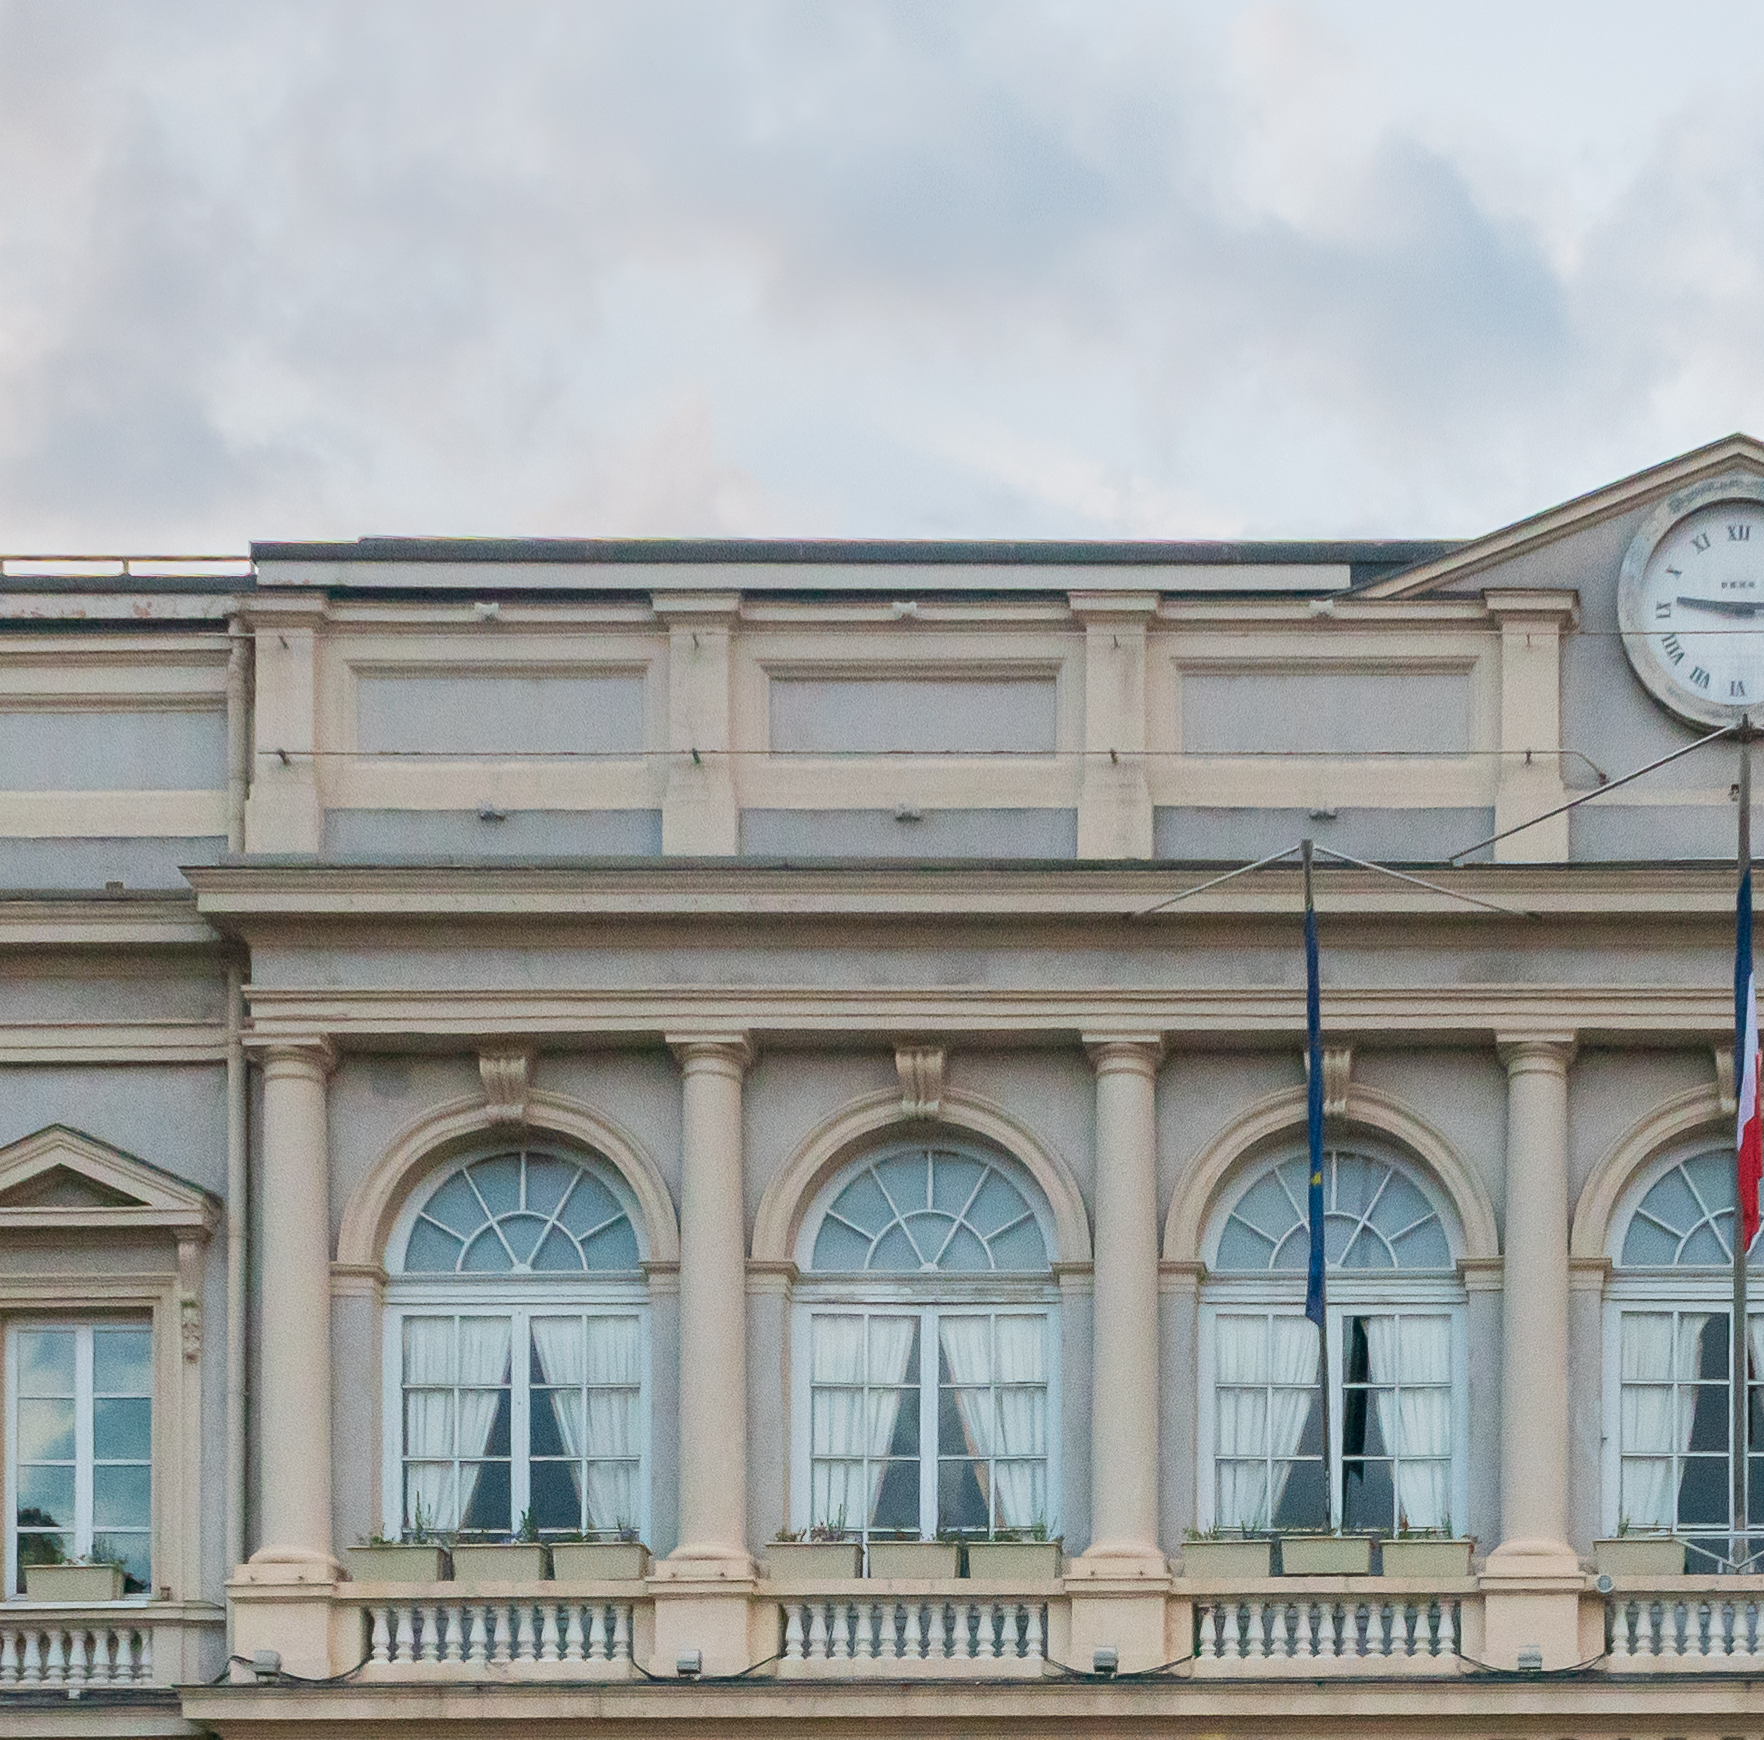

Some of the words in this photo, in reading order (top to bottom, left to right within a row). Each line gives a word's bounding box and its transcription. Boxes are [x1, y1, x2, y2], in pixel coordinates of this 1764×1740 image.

[1728, 525, 1751, 541] XII
[1692, 532, 1711, 554] XI
[1656, 602, 1671, 619] IX
[1689, 666, 1710, 689] VII
[1729, 681, 1746, 697] VI
